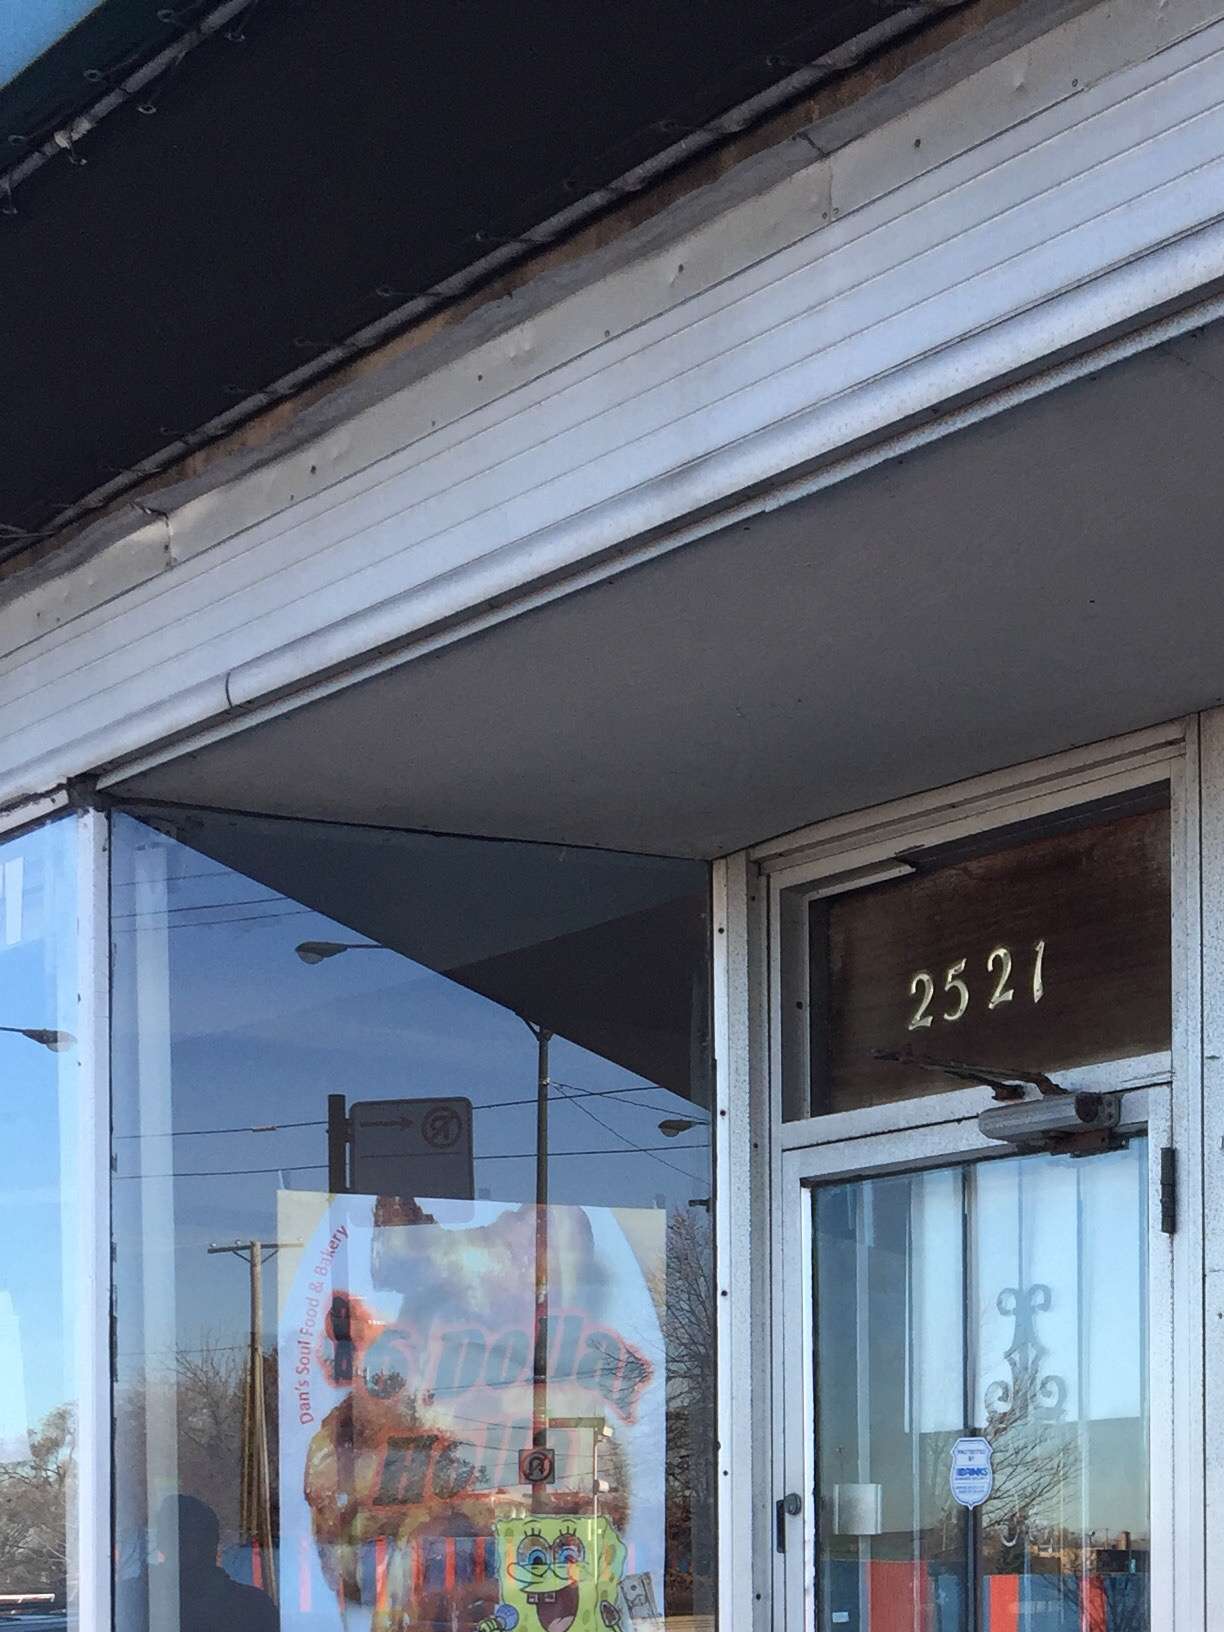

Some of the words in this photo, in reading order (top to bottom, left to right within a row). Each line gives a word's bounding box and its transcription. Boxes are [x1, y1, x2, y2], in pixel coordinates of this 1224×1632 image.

[908, 939, 1046, 1031] 2521
[314, 1224, 349, 1277] Bakery
[309, 1282, 325, 1294] &
[300, 1296, 320, 1337] Food
[296, 1339, 312, 1377] Soul
[294, 1379, 314, 1425] Dan's
